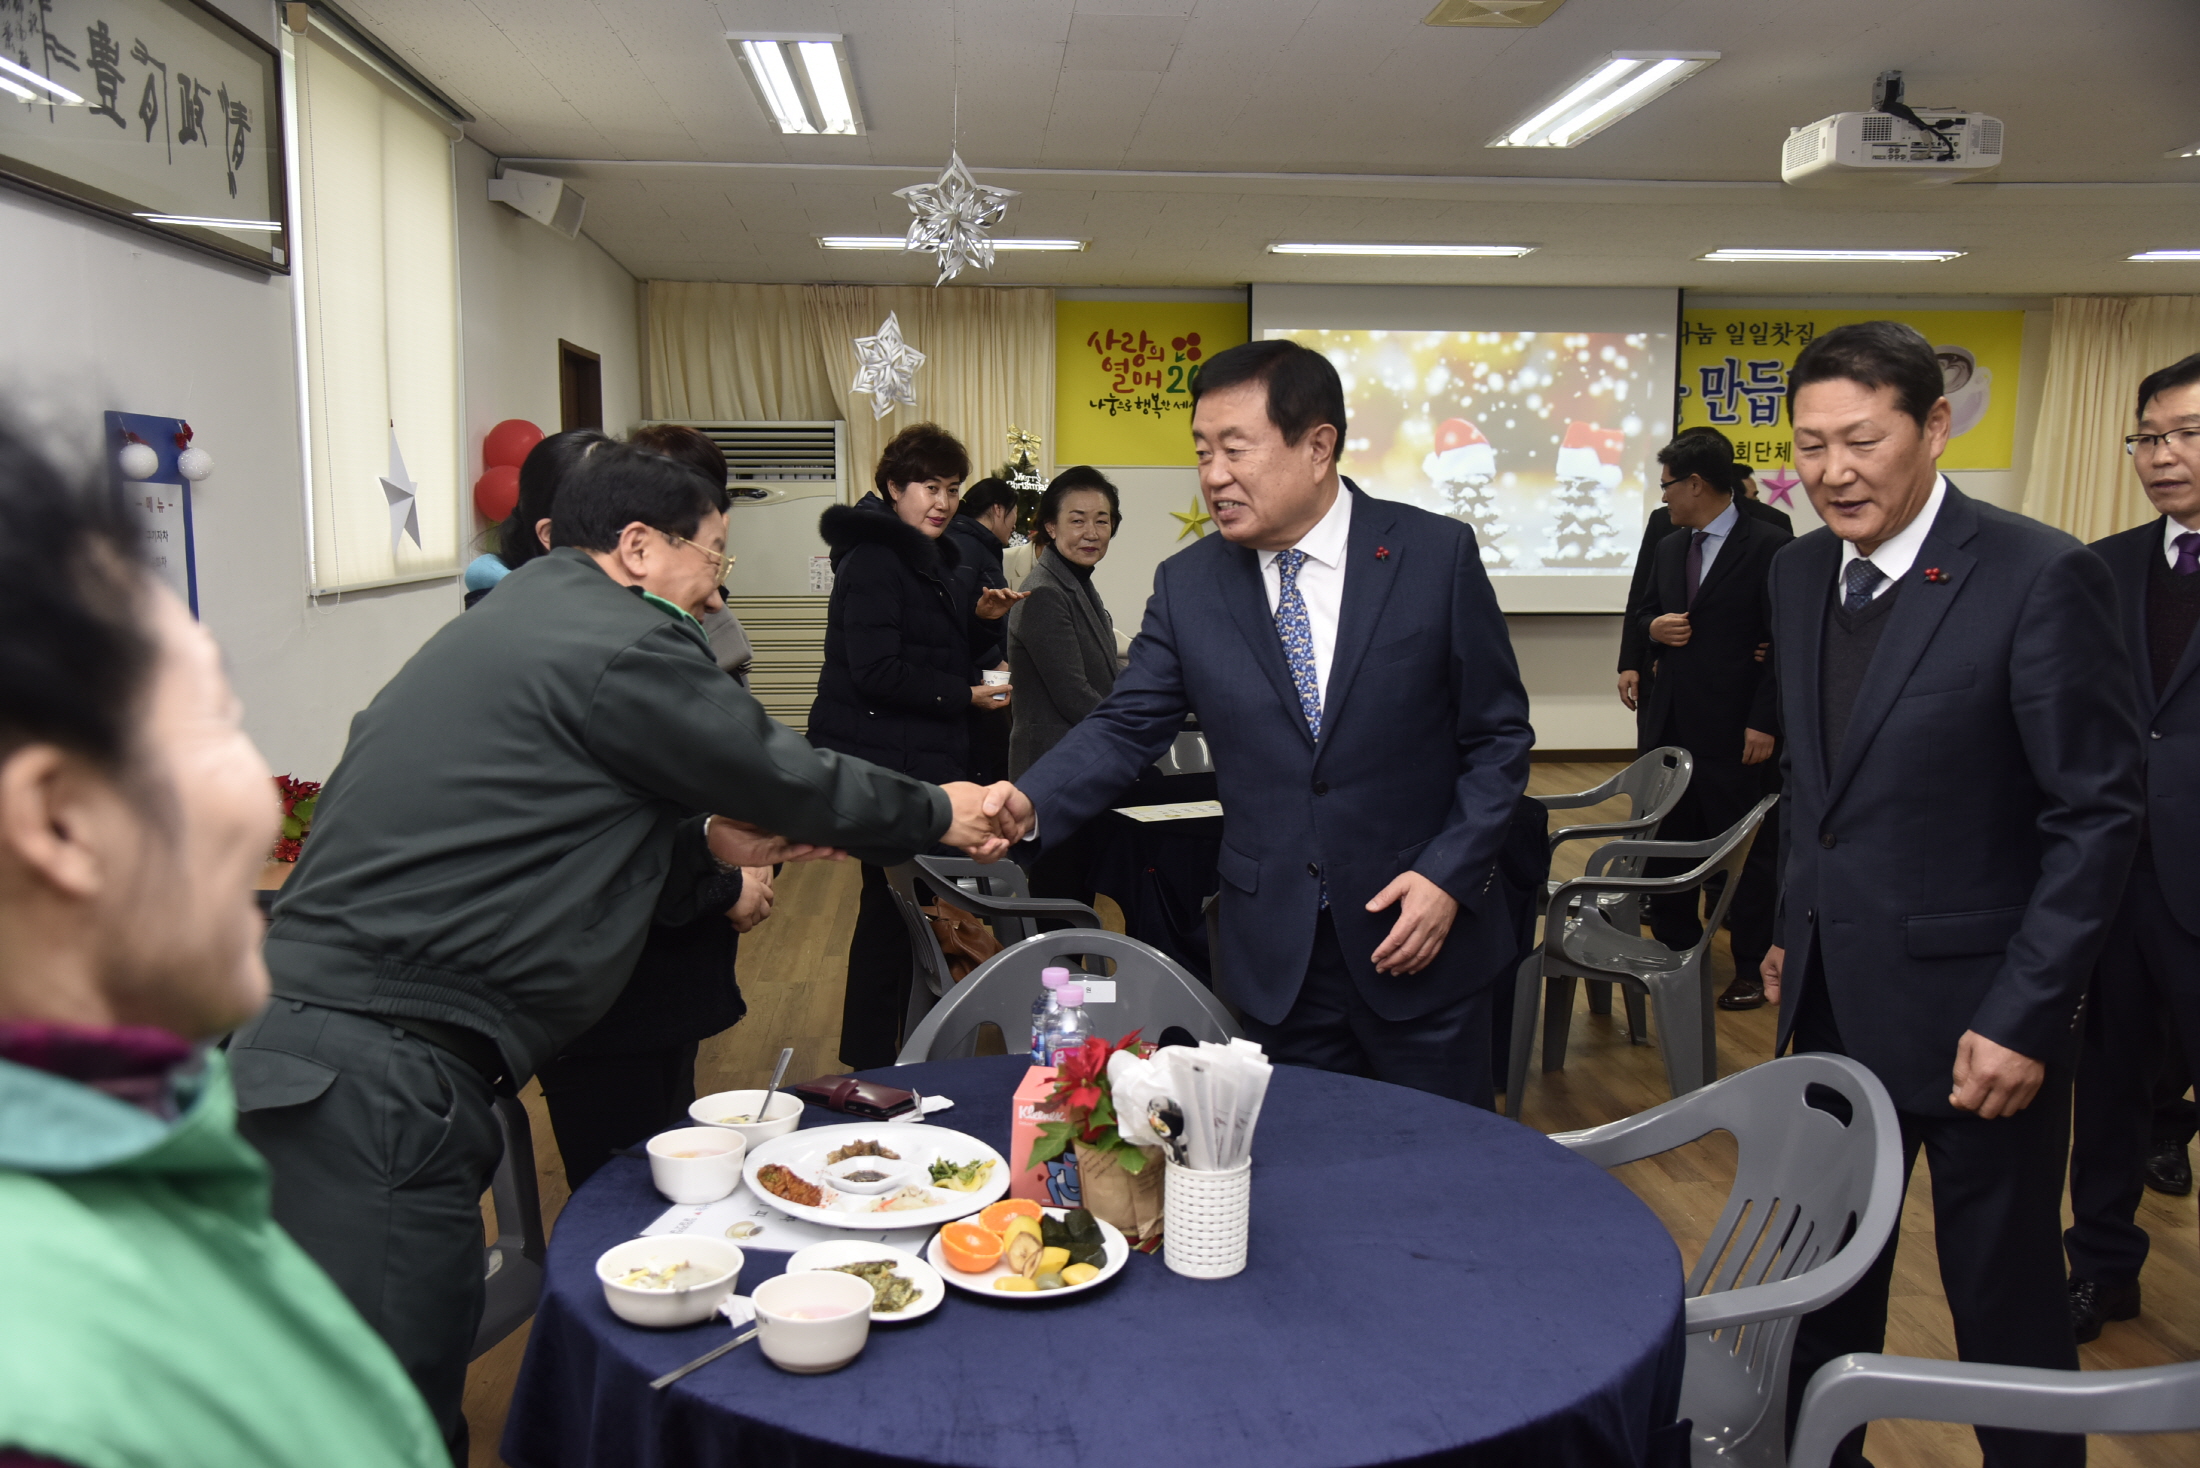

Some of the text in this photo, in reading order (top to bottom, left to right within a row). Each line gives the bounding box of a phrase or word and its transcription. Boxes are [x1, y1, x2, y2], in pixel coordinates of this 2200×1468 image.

[1726, 321, 1815, 346] 일일찻집
[1087, 328, 1165, 367] 사랑의
[1101, 357, 1162, 393] 열매
[1134, 393, 1171, 419] 행복한
[1010, 466, 1042, 484] Merry
[1018, 1104, 1066, 1122] Kleenex
